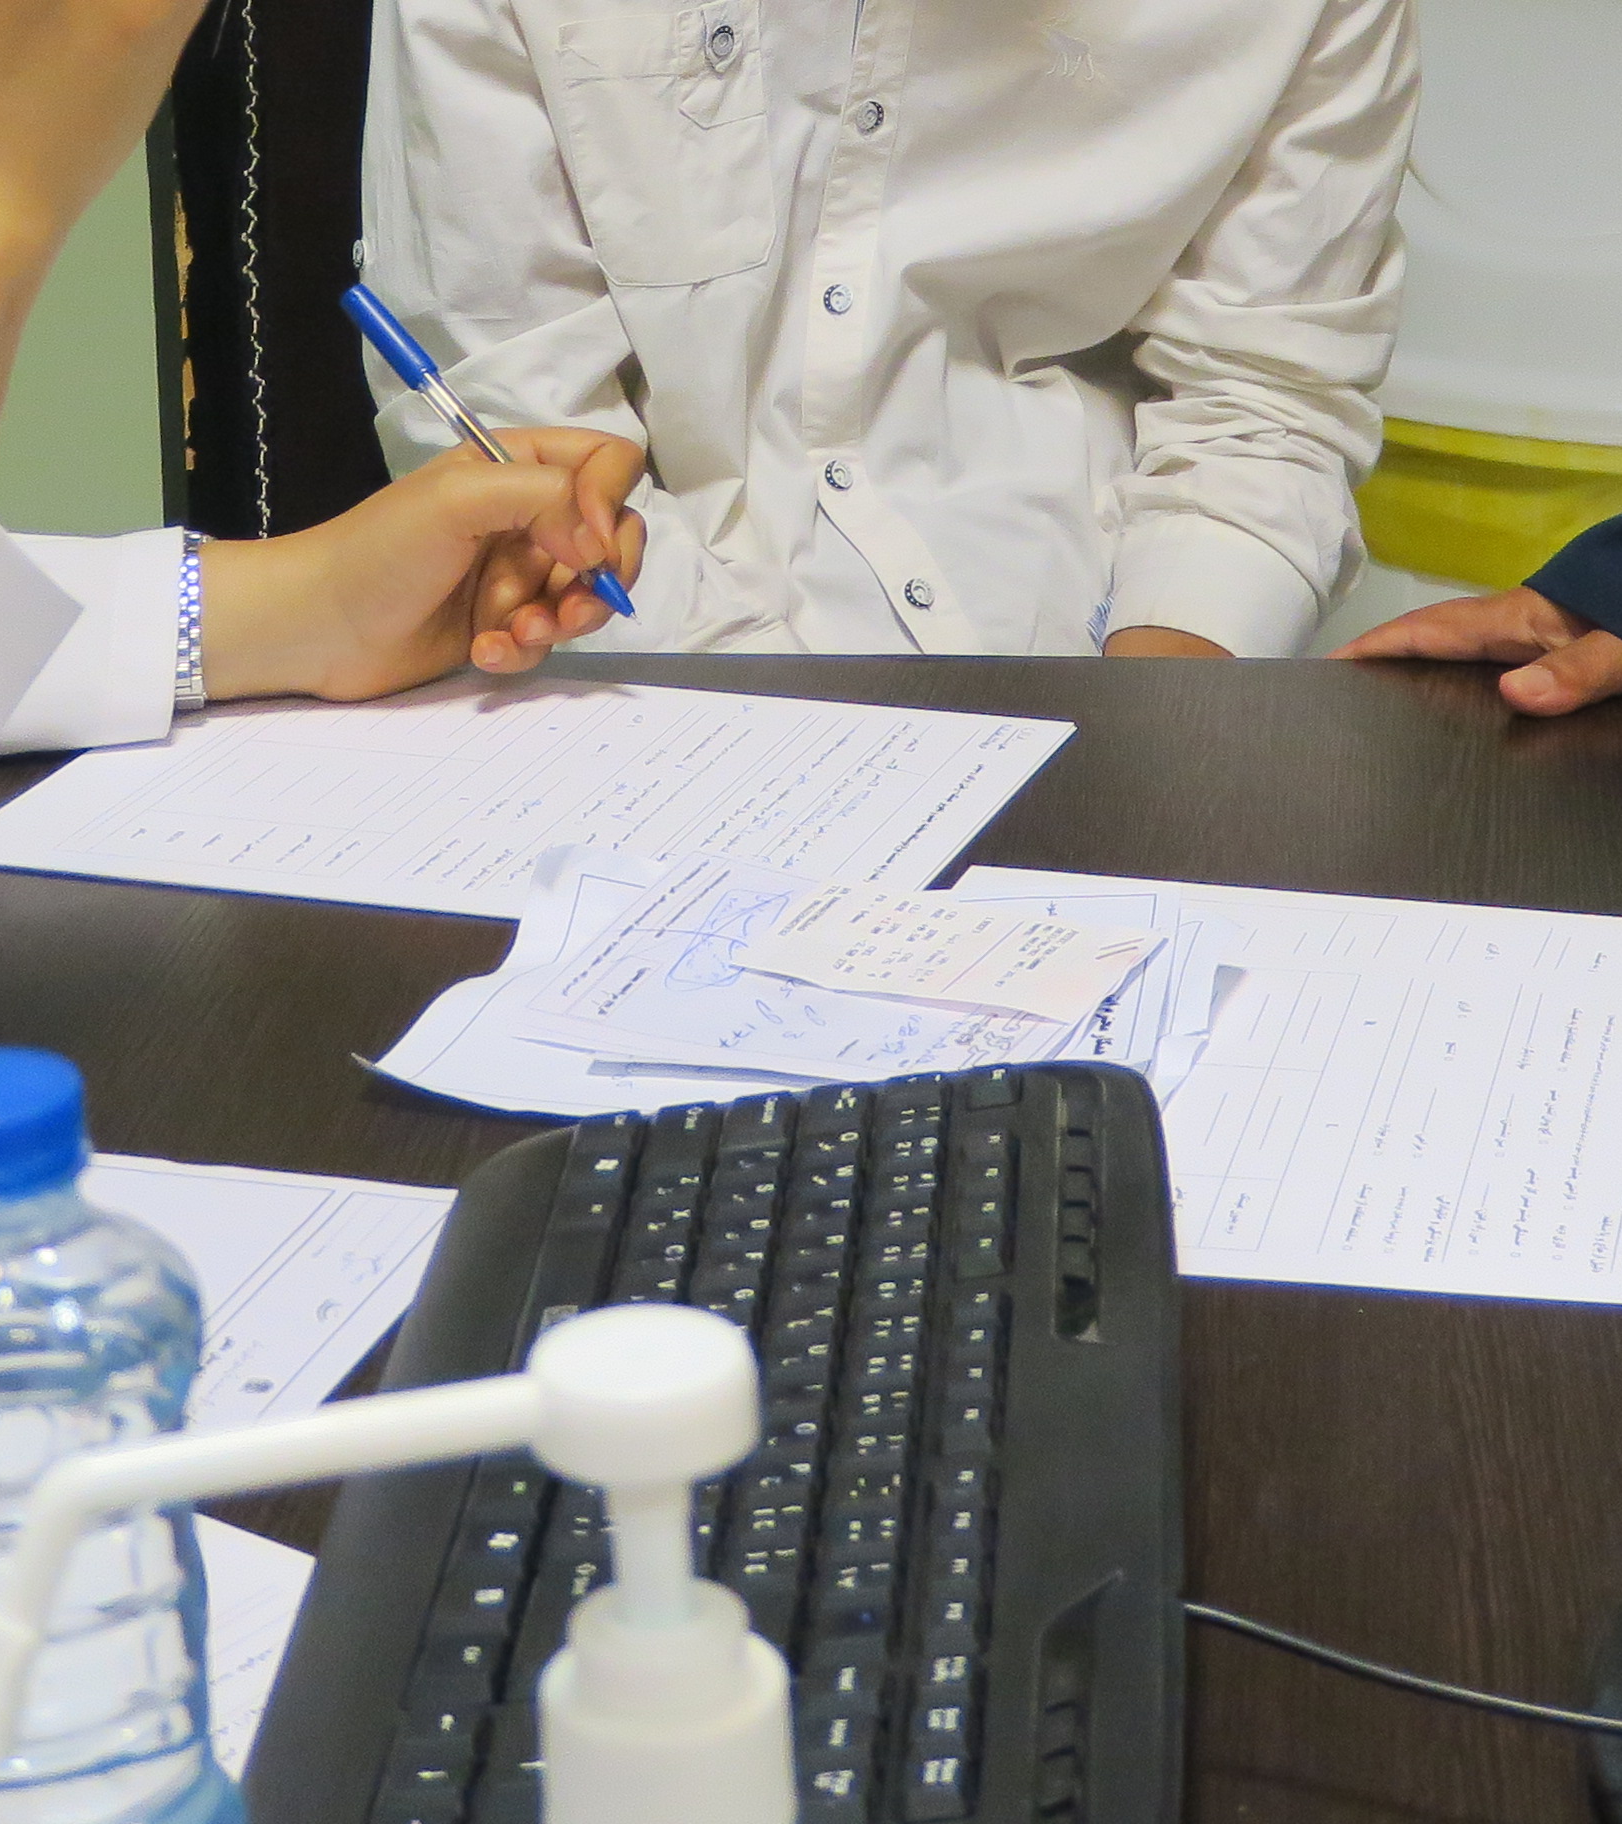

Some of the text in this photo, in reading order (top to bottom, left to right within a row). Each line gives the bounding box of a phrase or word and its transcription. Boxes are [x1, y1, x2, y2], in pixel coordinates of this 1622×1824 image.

[835, 1165, 854, 1177] W
[679, 1176, 700, 1184] Z
[756, 1183, 775, 1193] S
[673, 1209, 691, 1220] X
[826, 1235, 845, 1245] R
[665, 1245, 685, 1255] C
[658, 1279, 677, 1290] V
[814, 1307, 834, 1317] Y
[808, 1344, 829, 1355] U
